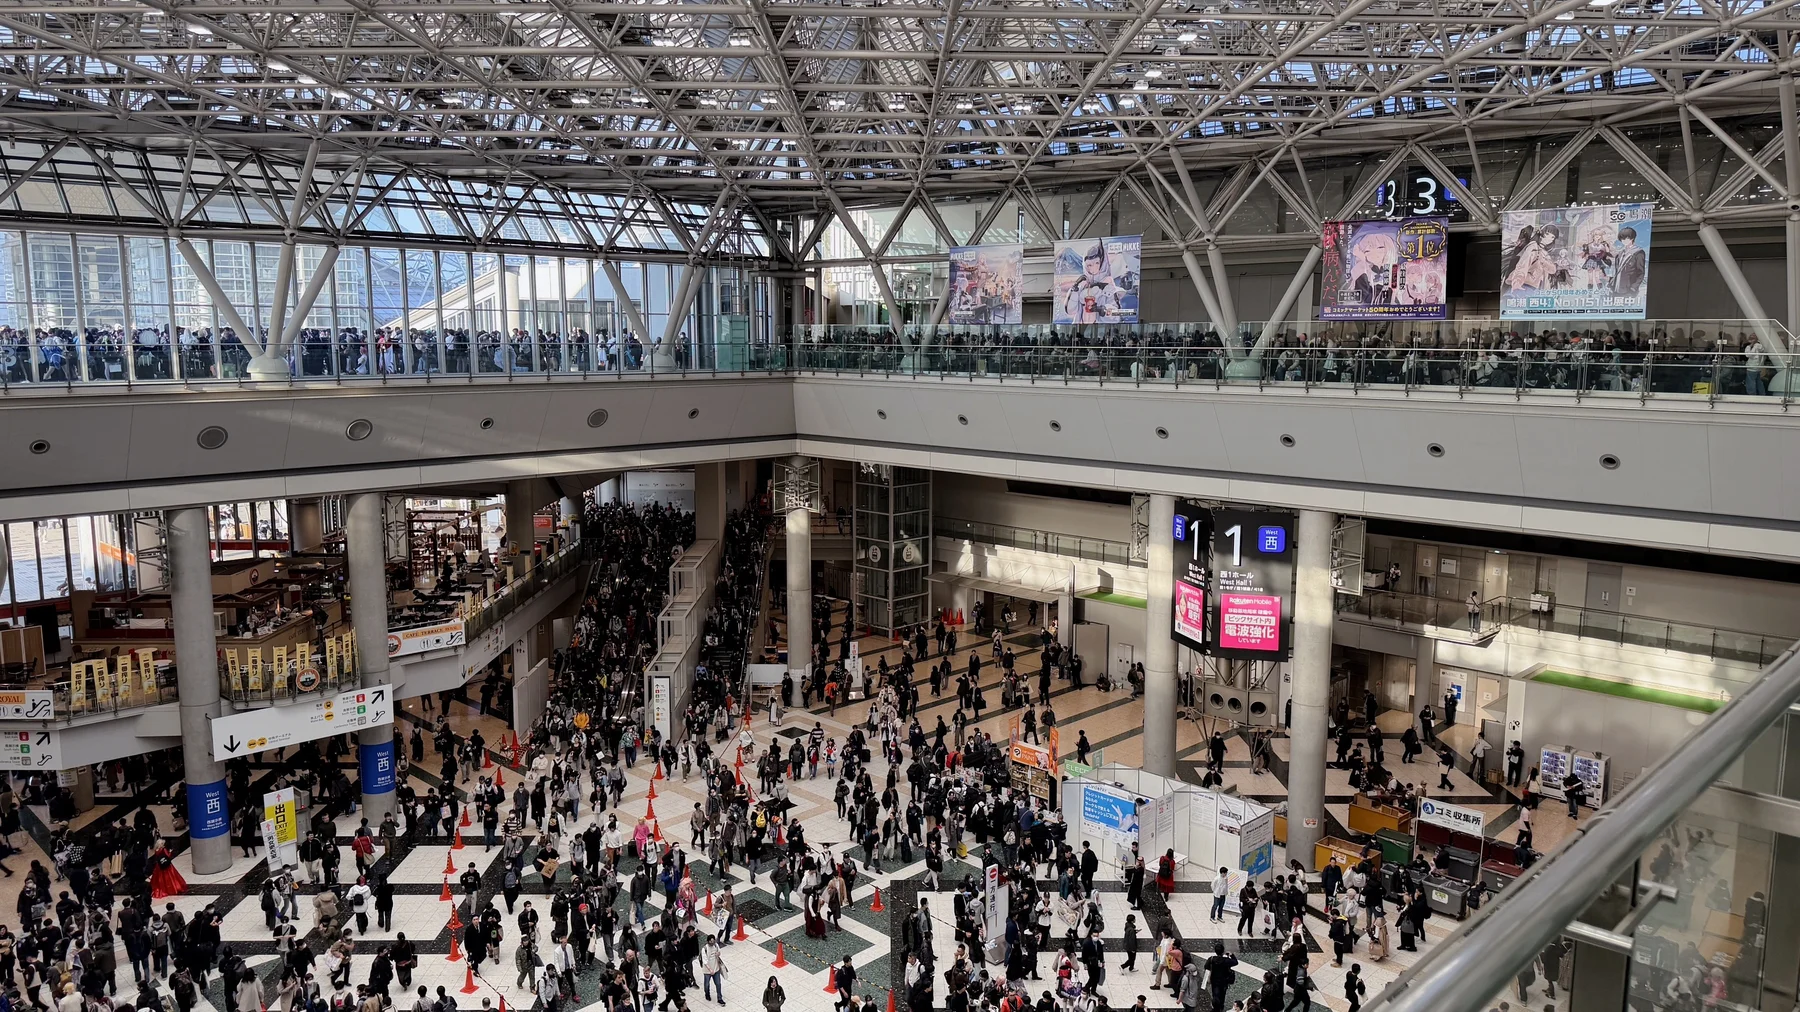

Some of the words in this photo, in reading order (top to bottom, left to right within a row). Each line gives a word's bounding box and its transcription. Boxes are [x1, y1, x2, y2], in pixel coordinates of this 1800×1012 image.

[1385, 179, 1396, 217] 3
[1413, 177, 1437, 215] 3
[1190, 520, 1199, 560] 1
[1225, 525, 1241, 566] 1
[1265, 536, 1277, 550] 西
[1220, 571, 1254, 579] 西1ホール
[1229, 597, 1254, 605] Rakuten
[1225, 624, 1274, 639] 電波強化
[378, 757, 389, 772] 西
[206, 797, 220, 814] 西
[275, 803, 286, 824] 出口
[1436, 806, 1481, 826] ゴミ収集所
[275, 821, 288, 831] EXIT
[989, 880, 997, 912] 一方通行
